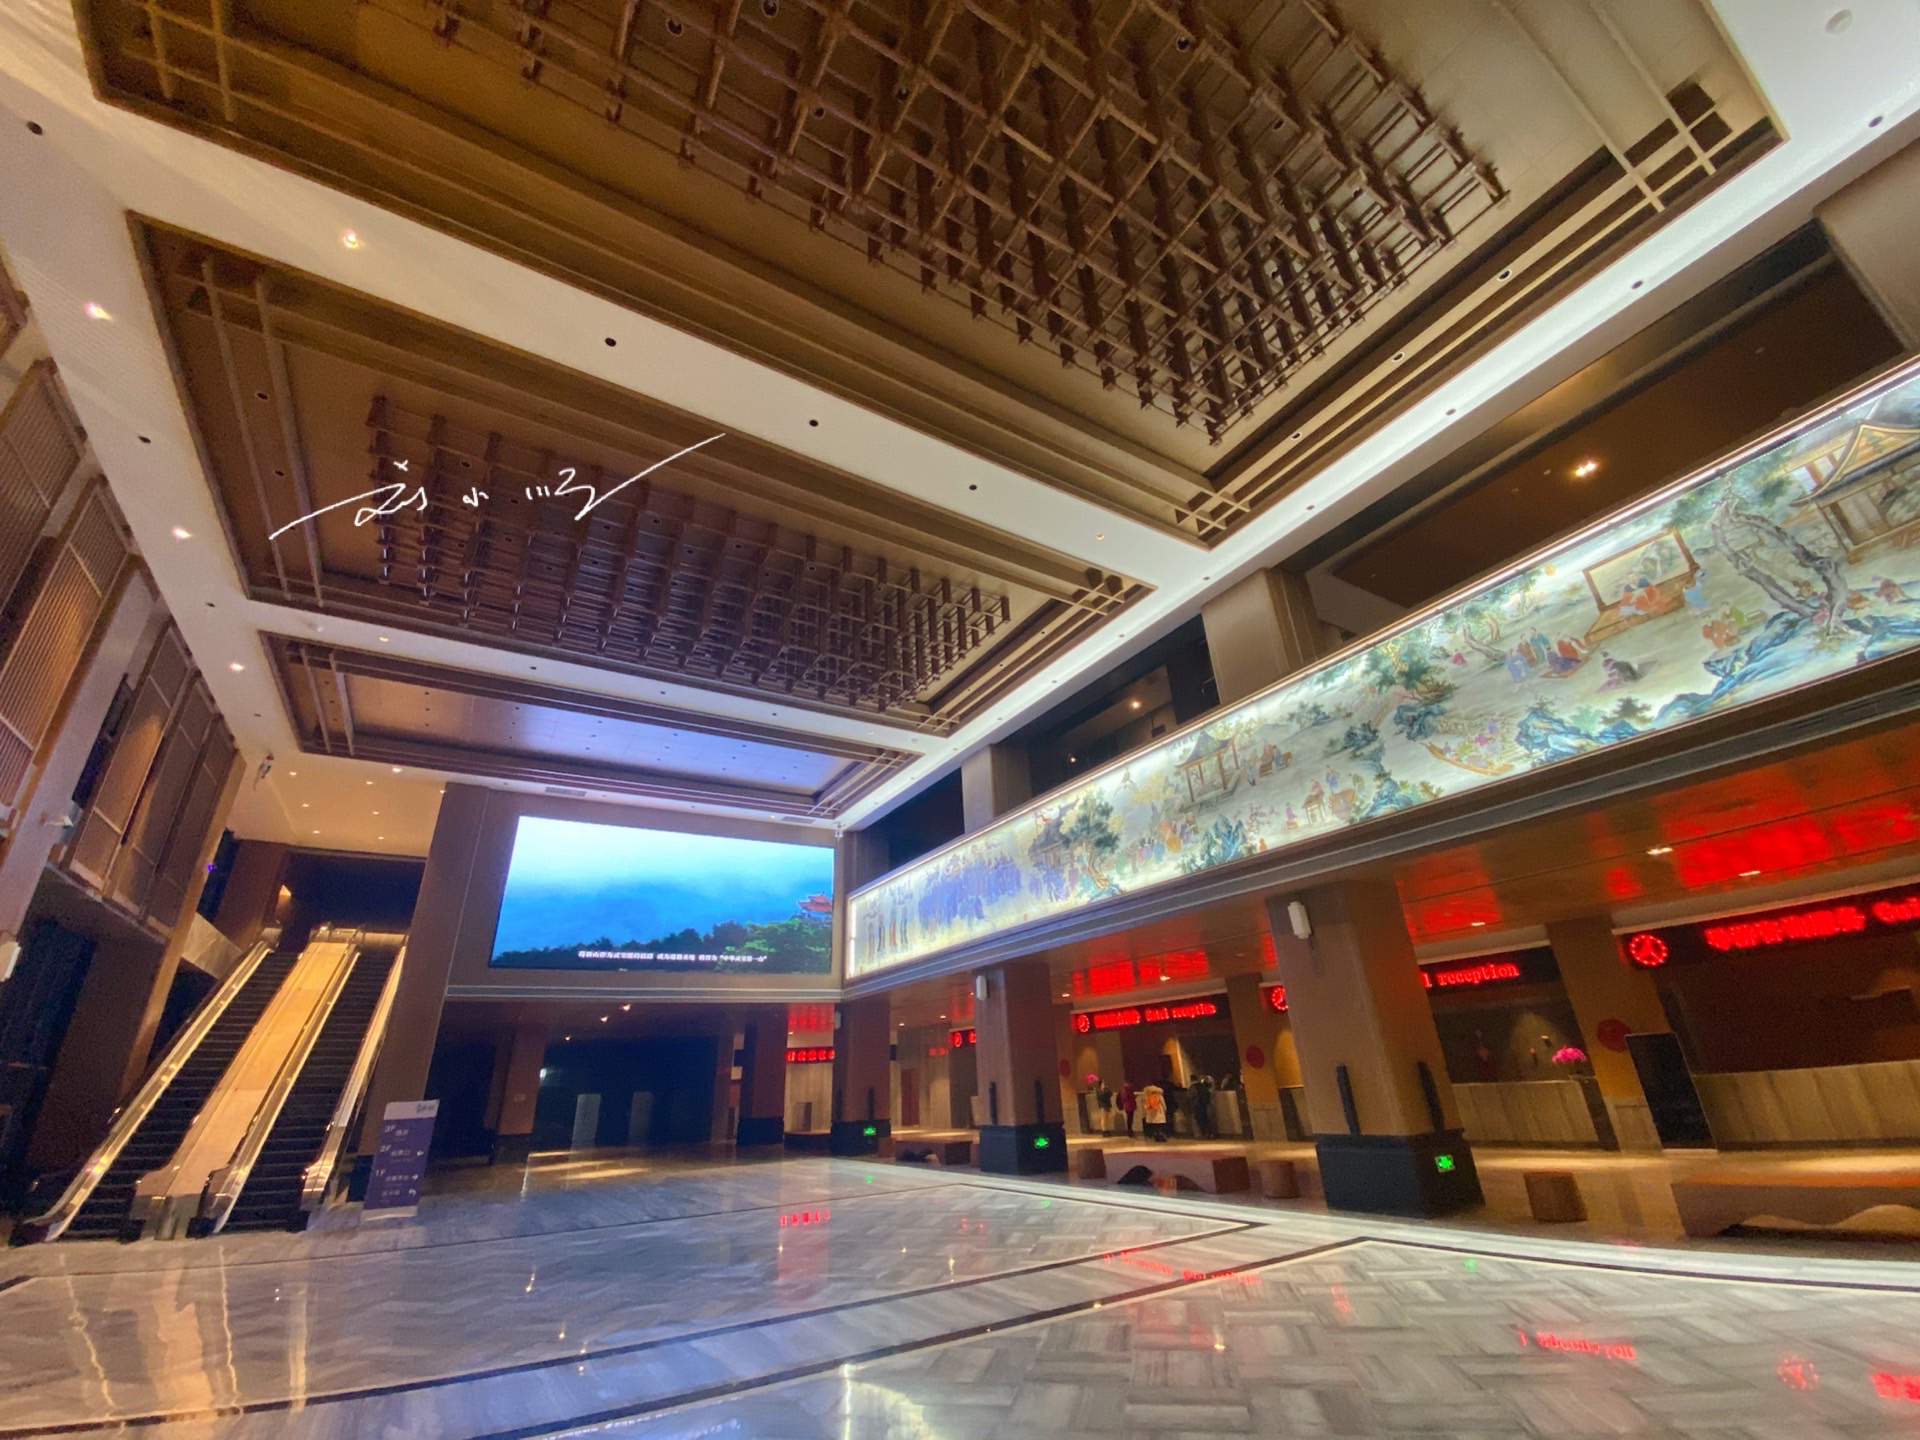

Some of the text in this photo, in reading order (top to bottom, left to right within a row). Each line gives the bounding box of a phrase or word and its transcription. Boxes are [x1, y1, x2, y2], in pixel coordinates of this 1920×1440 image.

[1436, 962, 1520, 986] reception
[385, 1125, 396, 1133] 3F
[380, 1144, 391, 1153] 2F
